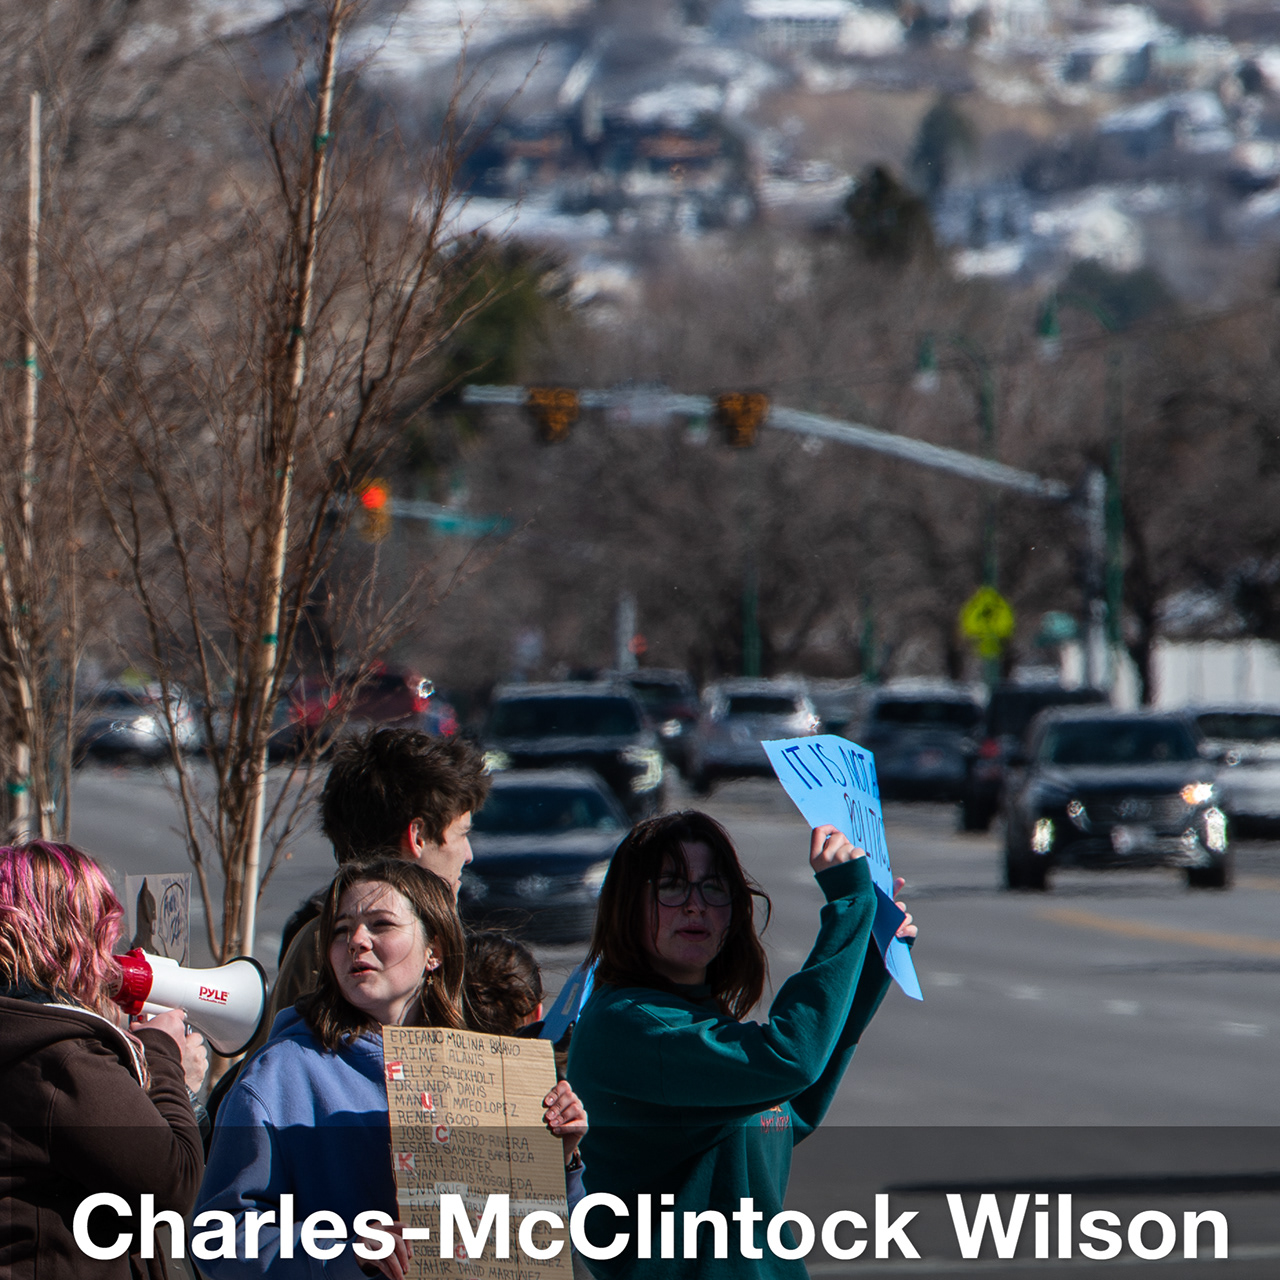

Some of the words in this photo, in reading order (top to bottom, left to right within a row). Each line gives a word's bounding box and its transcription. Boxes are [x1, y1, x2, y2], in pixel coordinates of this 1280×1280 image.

[781, 746, 823, 790] IT
[808, 743, 847, 787] IS
[838, 745, 871, 796] NOT
[447, 1032, 485, 1051] MOLINA
[392, 1046, 438, 1061] JAIME
[448, 1049, 485, 1067] ALANIS
[386, 1061, 433, 1081] FELIX
[395, 1080, 413, 1092] DR
[416, 1081, 453, 1093] LINDA
[457, 1083, 487, 1098] DAVIS
[395, 1092, 448, 1111] MANUEL
[453, 1098, 481, 1113] MATEO
[485, 1102, 519, 1117] LOPEZ
[397, 1110, 438, 1124] RENEE
[445, 1111, 479, 1128] GOOD
[398, 1126, 431, 1141] JOSE
[398, 1153, 443, 1171] KEITH
[451, 1158, 492, 1173] PORTER
[406, 1182, 461, 1197] ENRIQUE
[443, 1170, 475, 1184] LOUIS
[475, 1173, 533, 1192] MOSQUEDA
[410, 1213, 438, 1227] AXEL
[415, 1259, 452, 1276] YAHIR
[457, 1262, 485, 1277] DAVID
